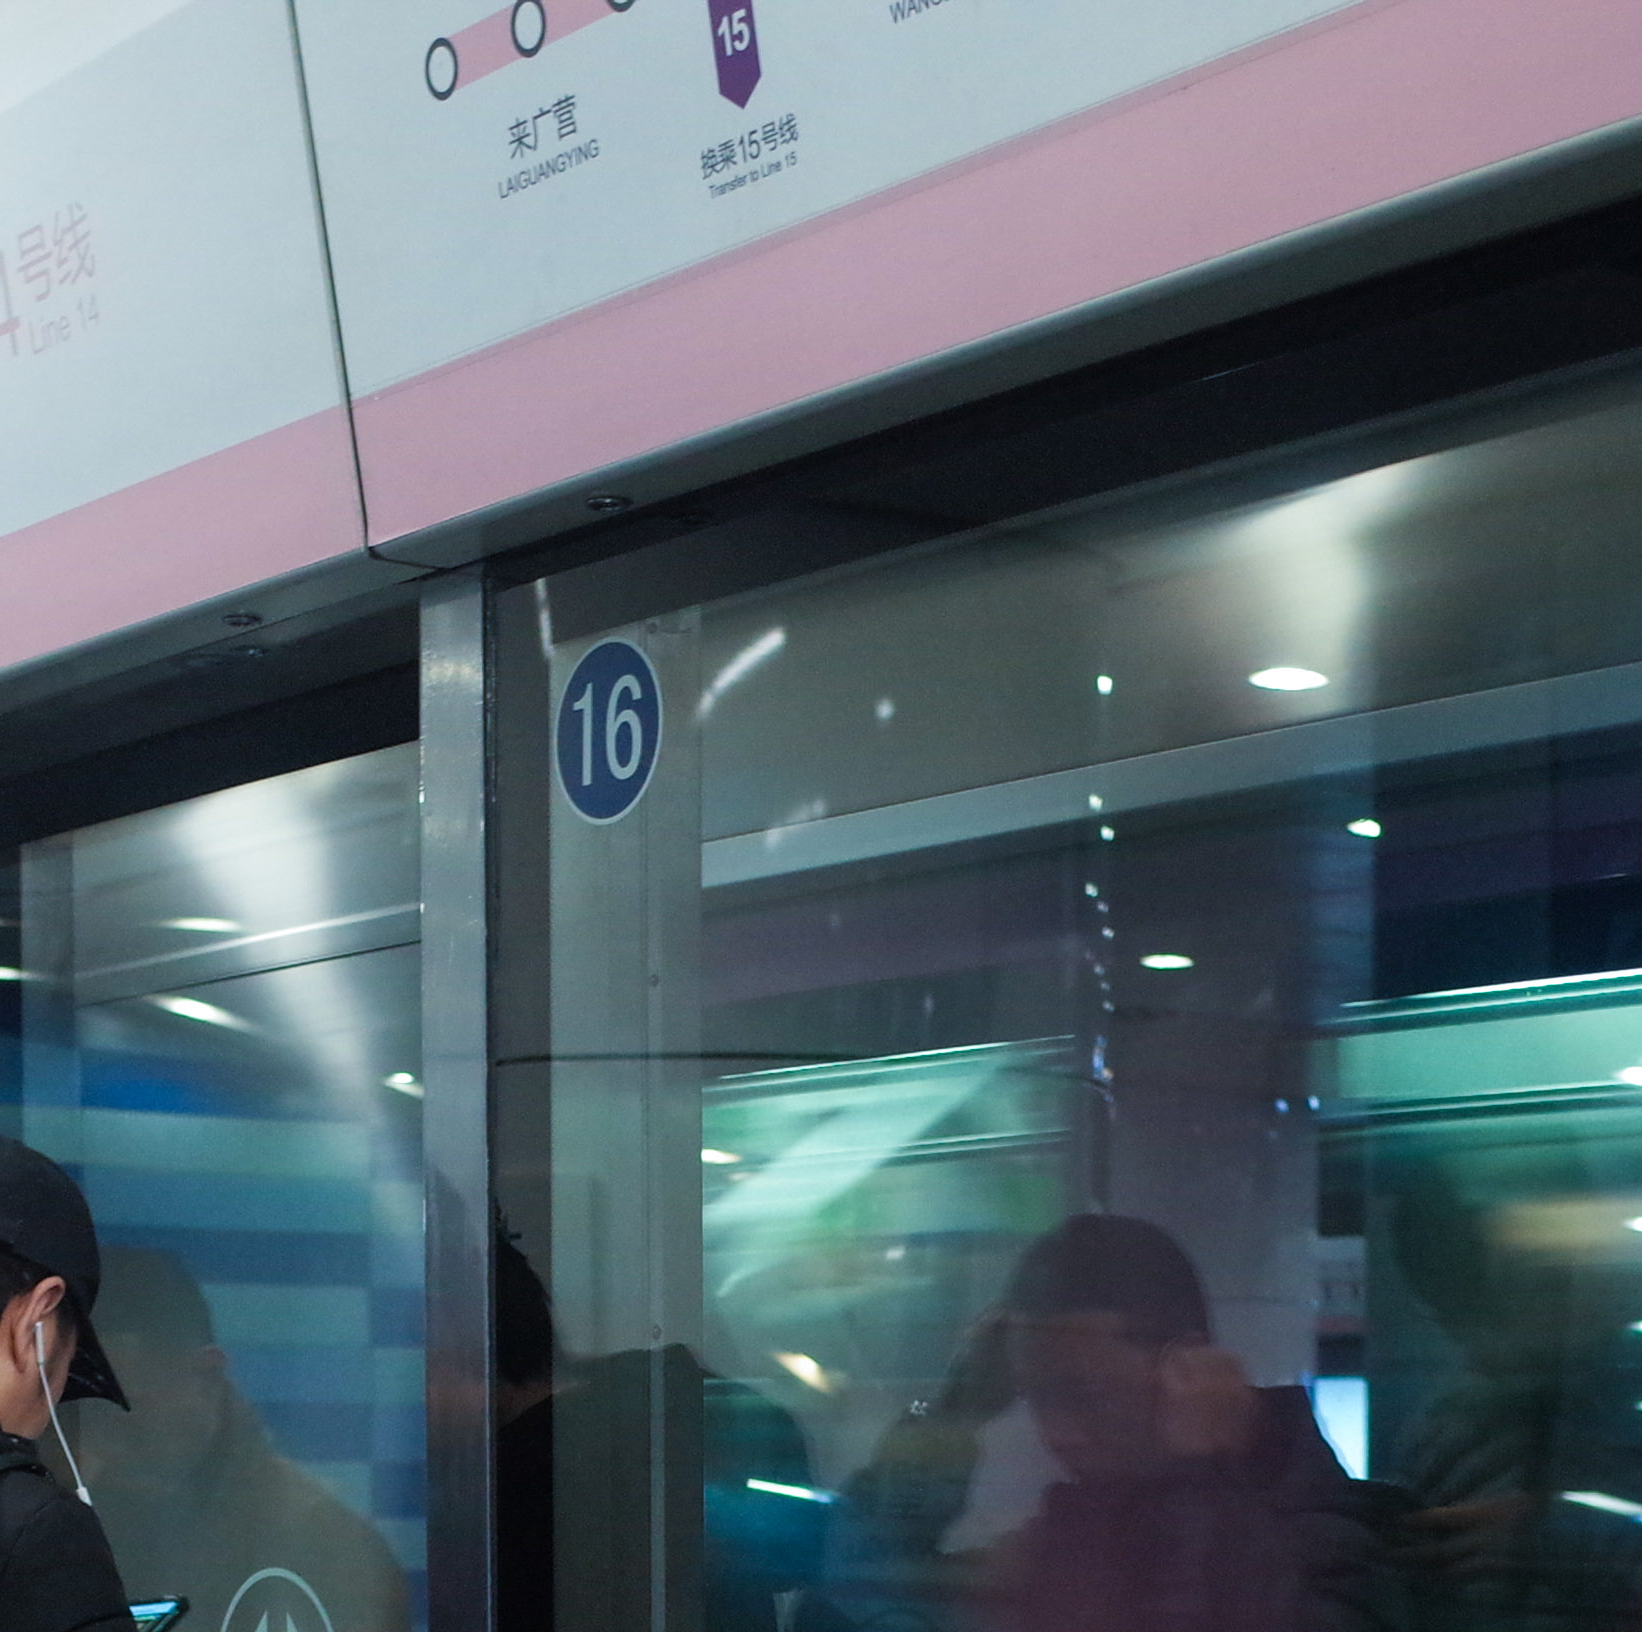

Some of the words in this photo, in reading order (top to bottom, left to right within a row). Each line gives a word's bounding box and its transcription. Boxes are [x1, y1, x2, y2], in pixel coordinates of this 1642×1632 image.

[717, 8, 752, 57] 15
[507, 94, 579, 160] 来广营
[701, 113, 799, 180] 换乘15号线
[497, 139, 601, 199] LAIGUANGYING
[709, 174, 748, 199] Transfer
[749, 170, 759, 182] to
[760, 161, 782, 178] Line
[785, 151, 797, 168] 15
[28, 315, 71, 355] Line
[76, 293, 100, 331] 14
[571, 673, 644, 787] 16
